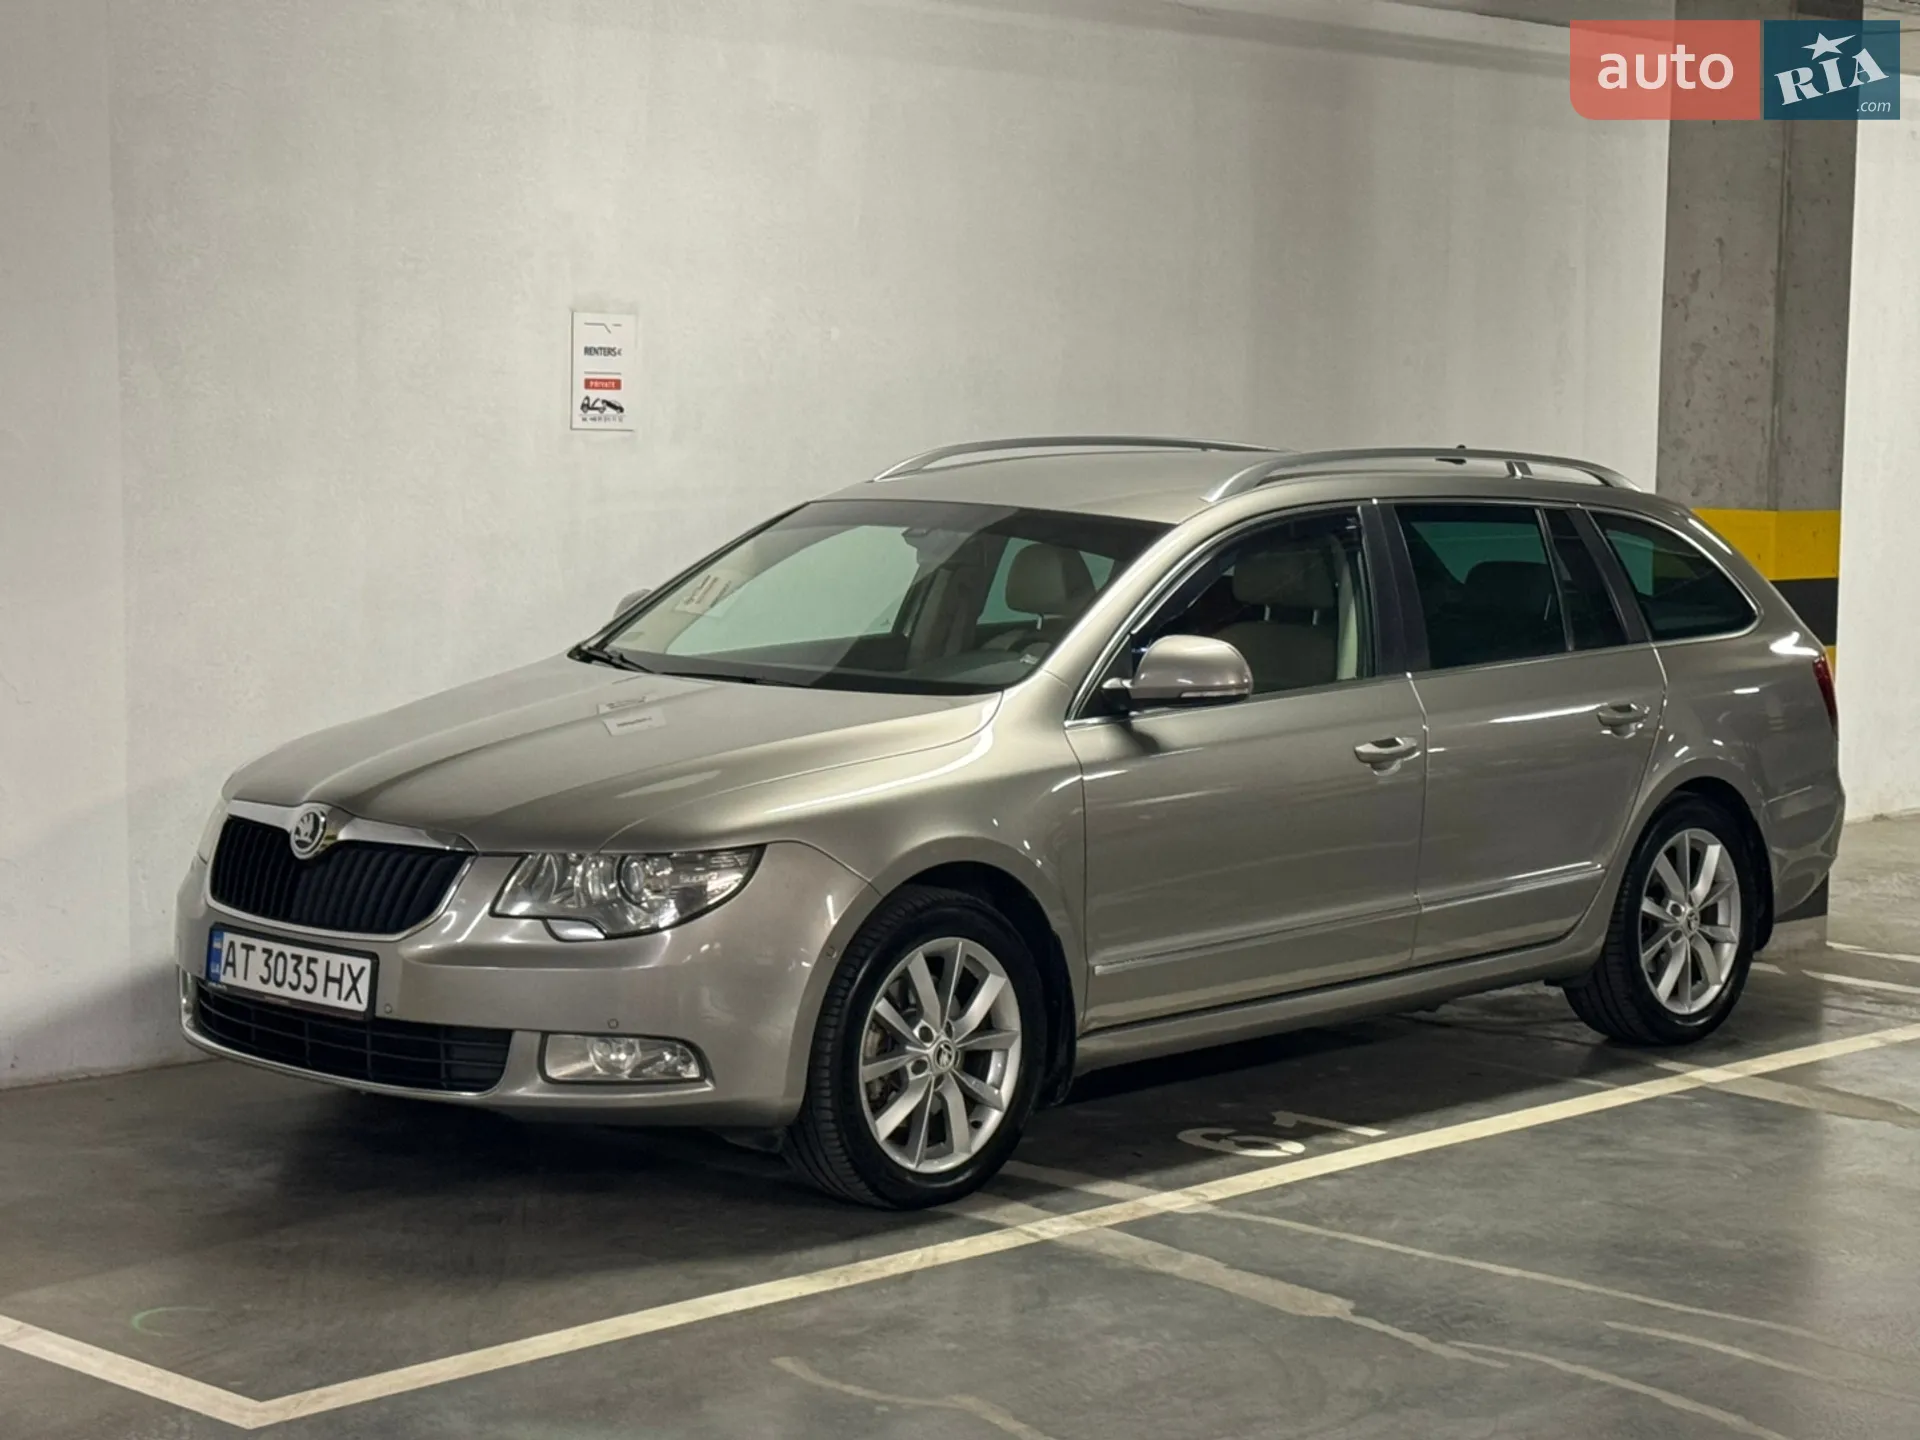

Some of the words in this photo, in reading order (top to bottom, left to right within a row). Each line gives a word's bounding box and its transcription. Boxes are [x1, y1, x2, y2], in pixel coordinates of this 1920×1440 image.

[222, 940, 257, 981] AT
[259, 947, 319, 994] 3035
[323, 959, 366, 1005] HX
[1176, 1111, 1388, 1157] 61
